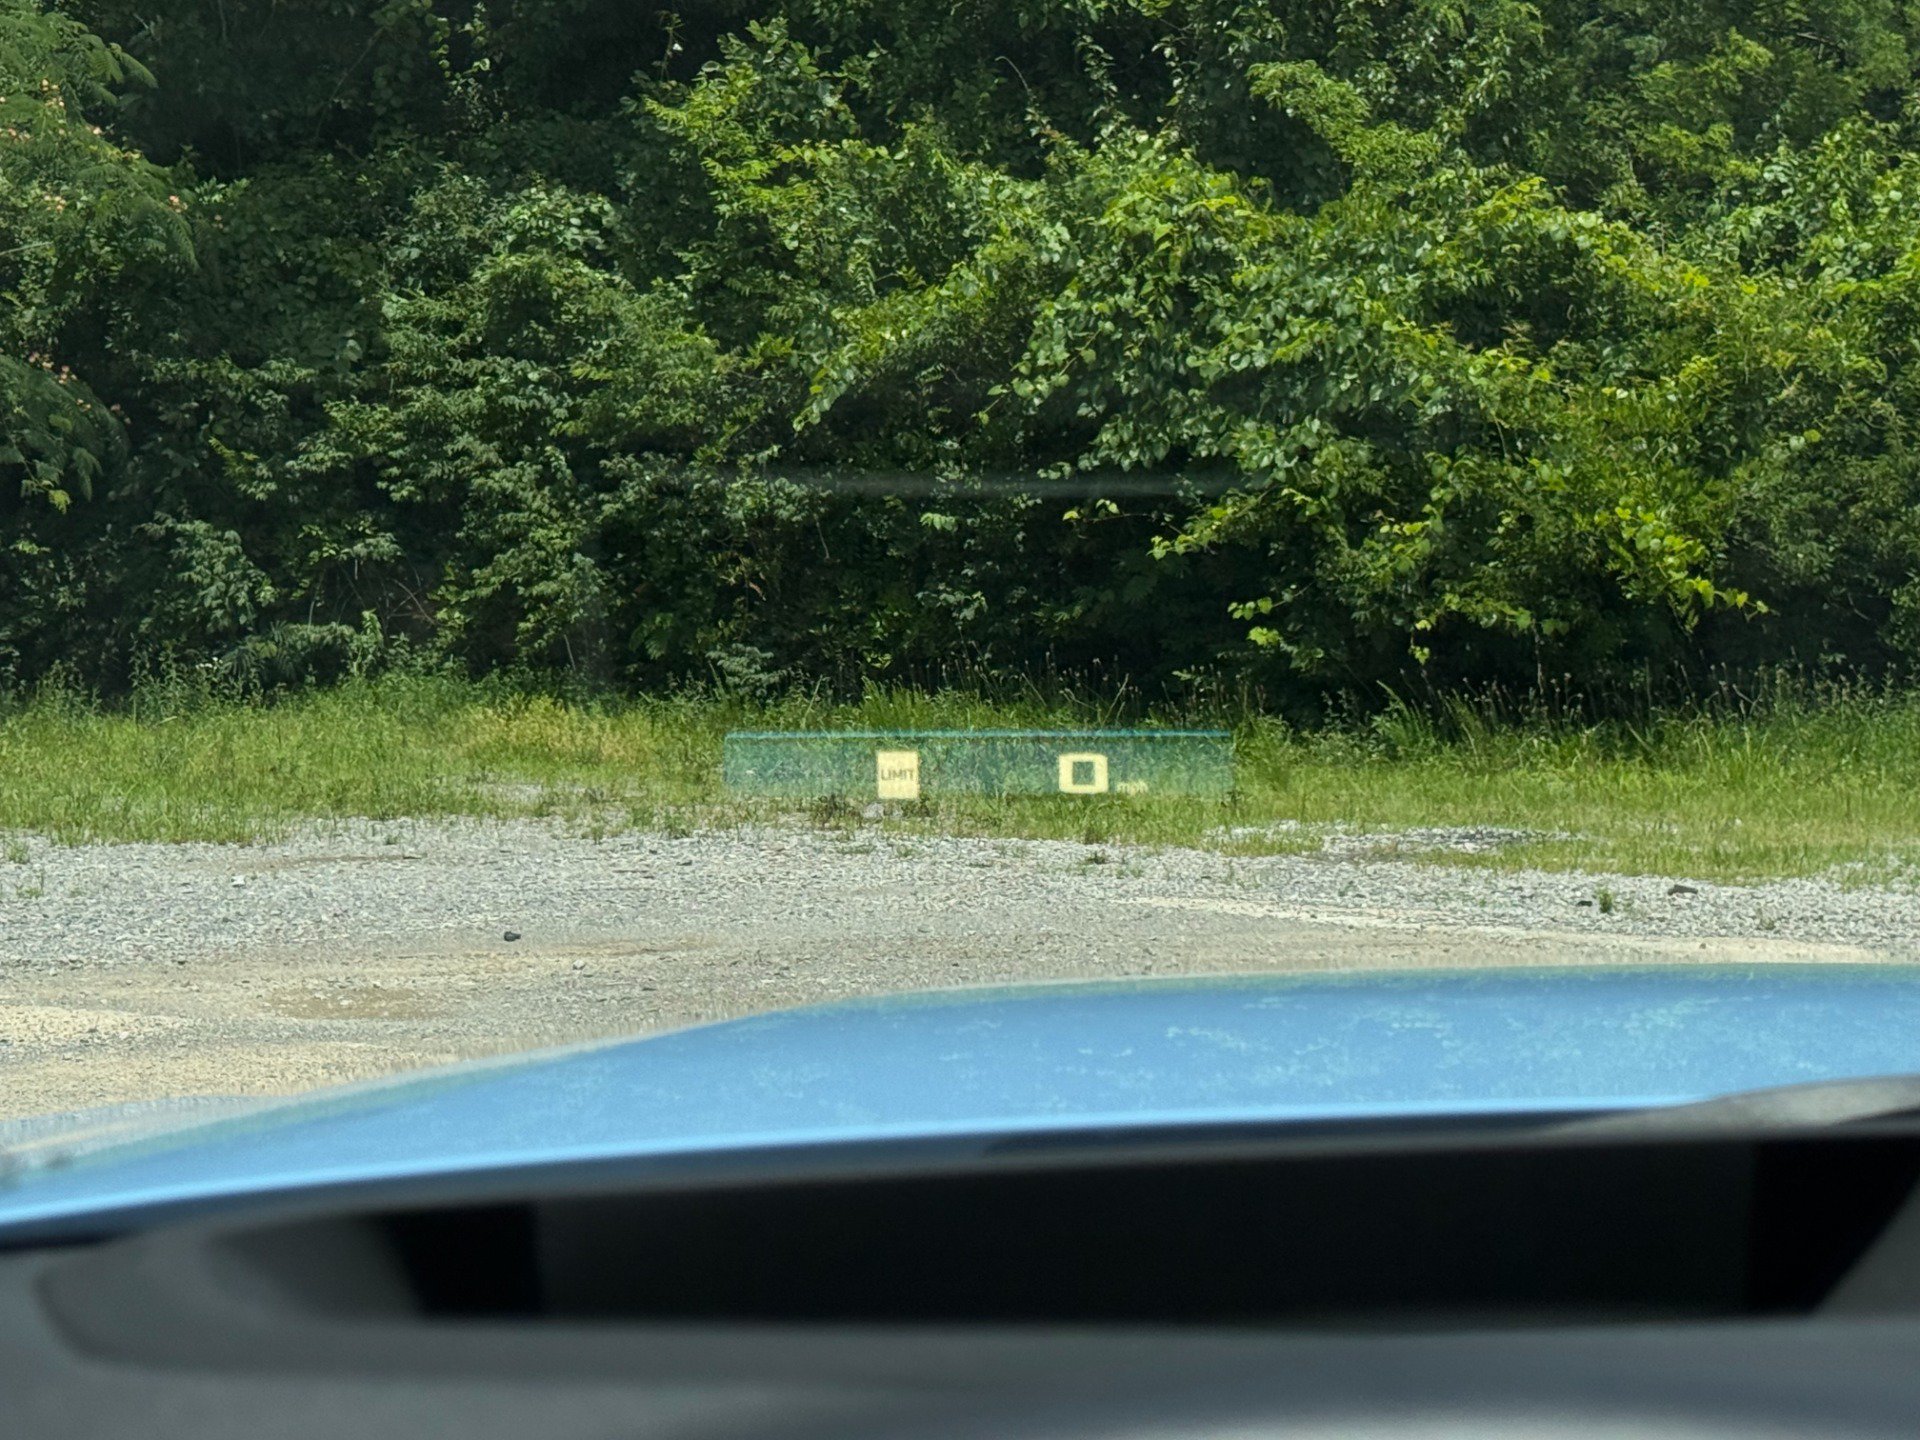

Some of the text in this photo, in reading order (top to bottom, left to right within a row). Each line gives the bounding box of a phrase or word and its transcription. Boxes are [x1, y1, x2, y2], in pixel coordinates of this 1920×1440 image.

[881, 768, 914, 781] LIMIT
[1058, 753, 1148, 797] 0 mph
